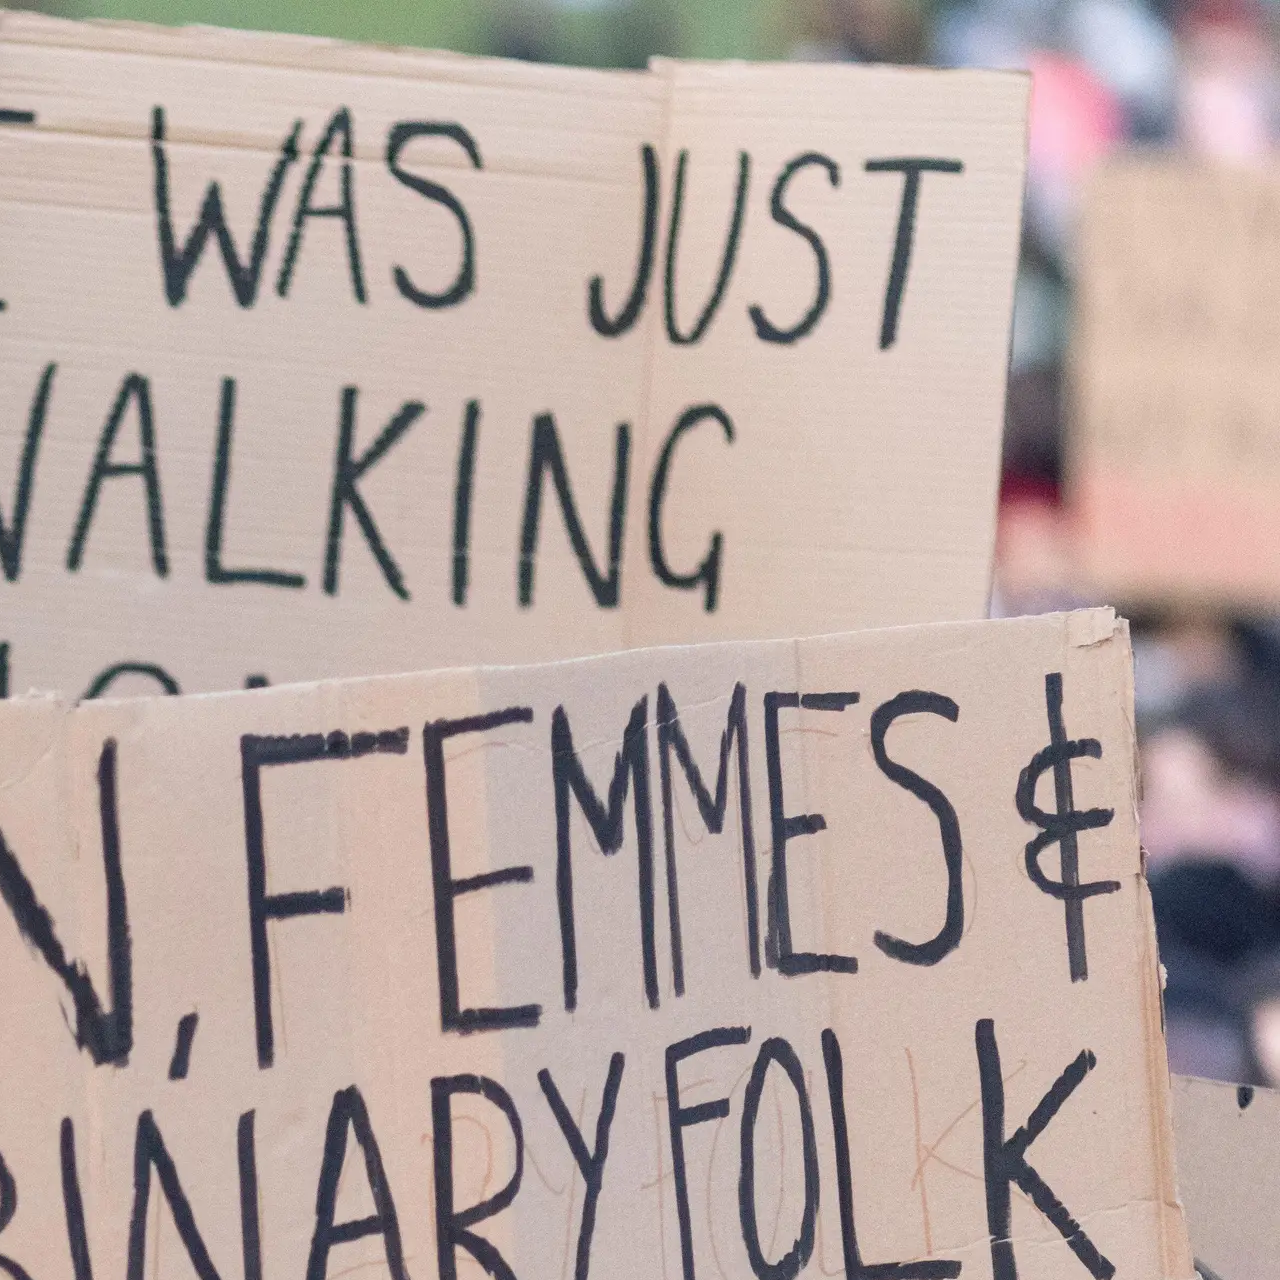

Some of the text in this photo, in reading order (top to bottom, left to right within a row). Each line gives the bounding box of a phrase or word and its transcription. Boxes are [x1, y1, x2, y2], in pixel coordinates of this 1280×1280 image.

[151, 105, 484, 310] WAS
[588, 143, 963, 351] JUST
[240, 682, 964, 1071] FEMMES
[1015, 672, 1122, 981] &
